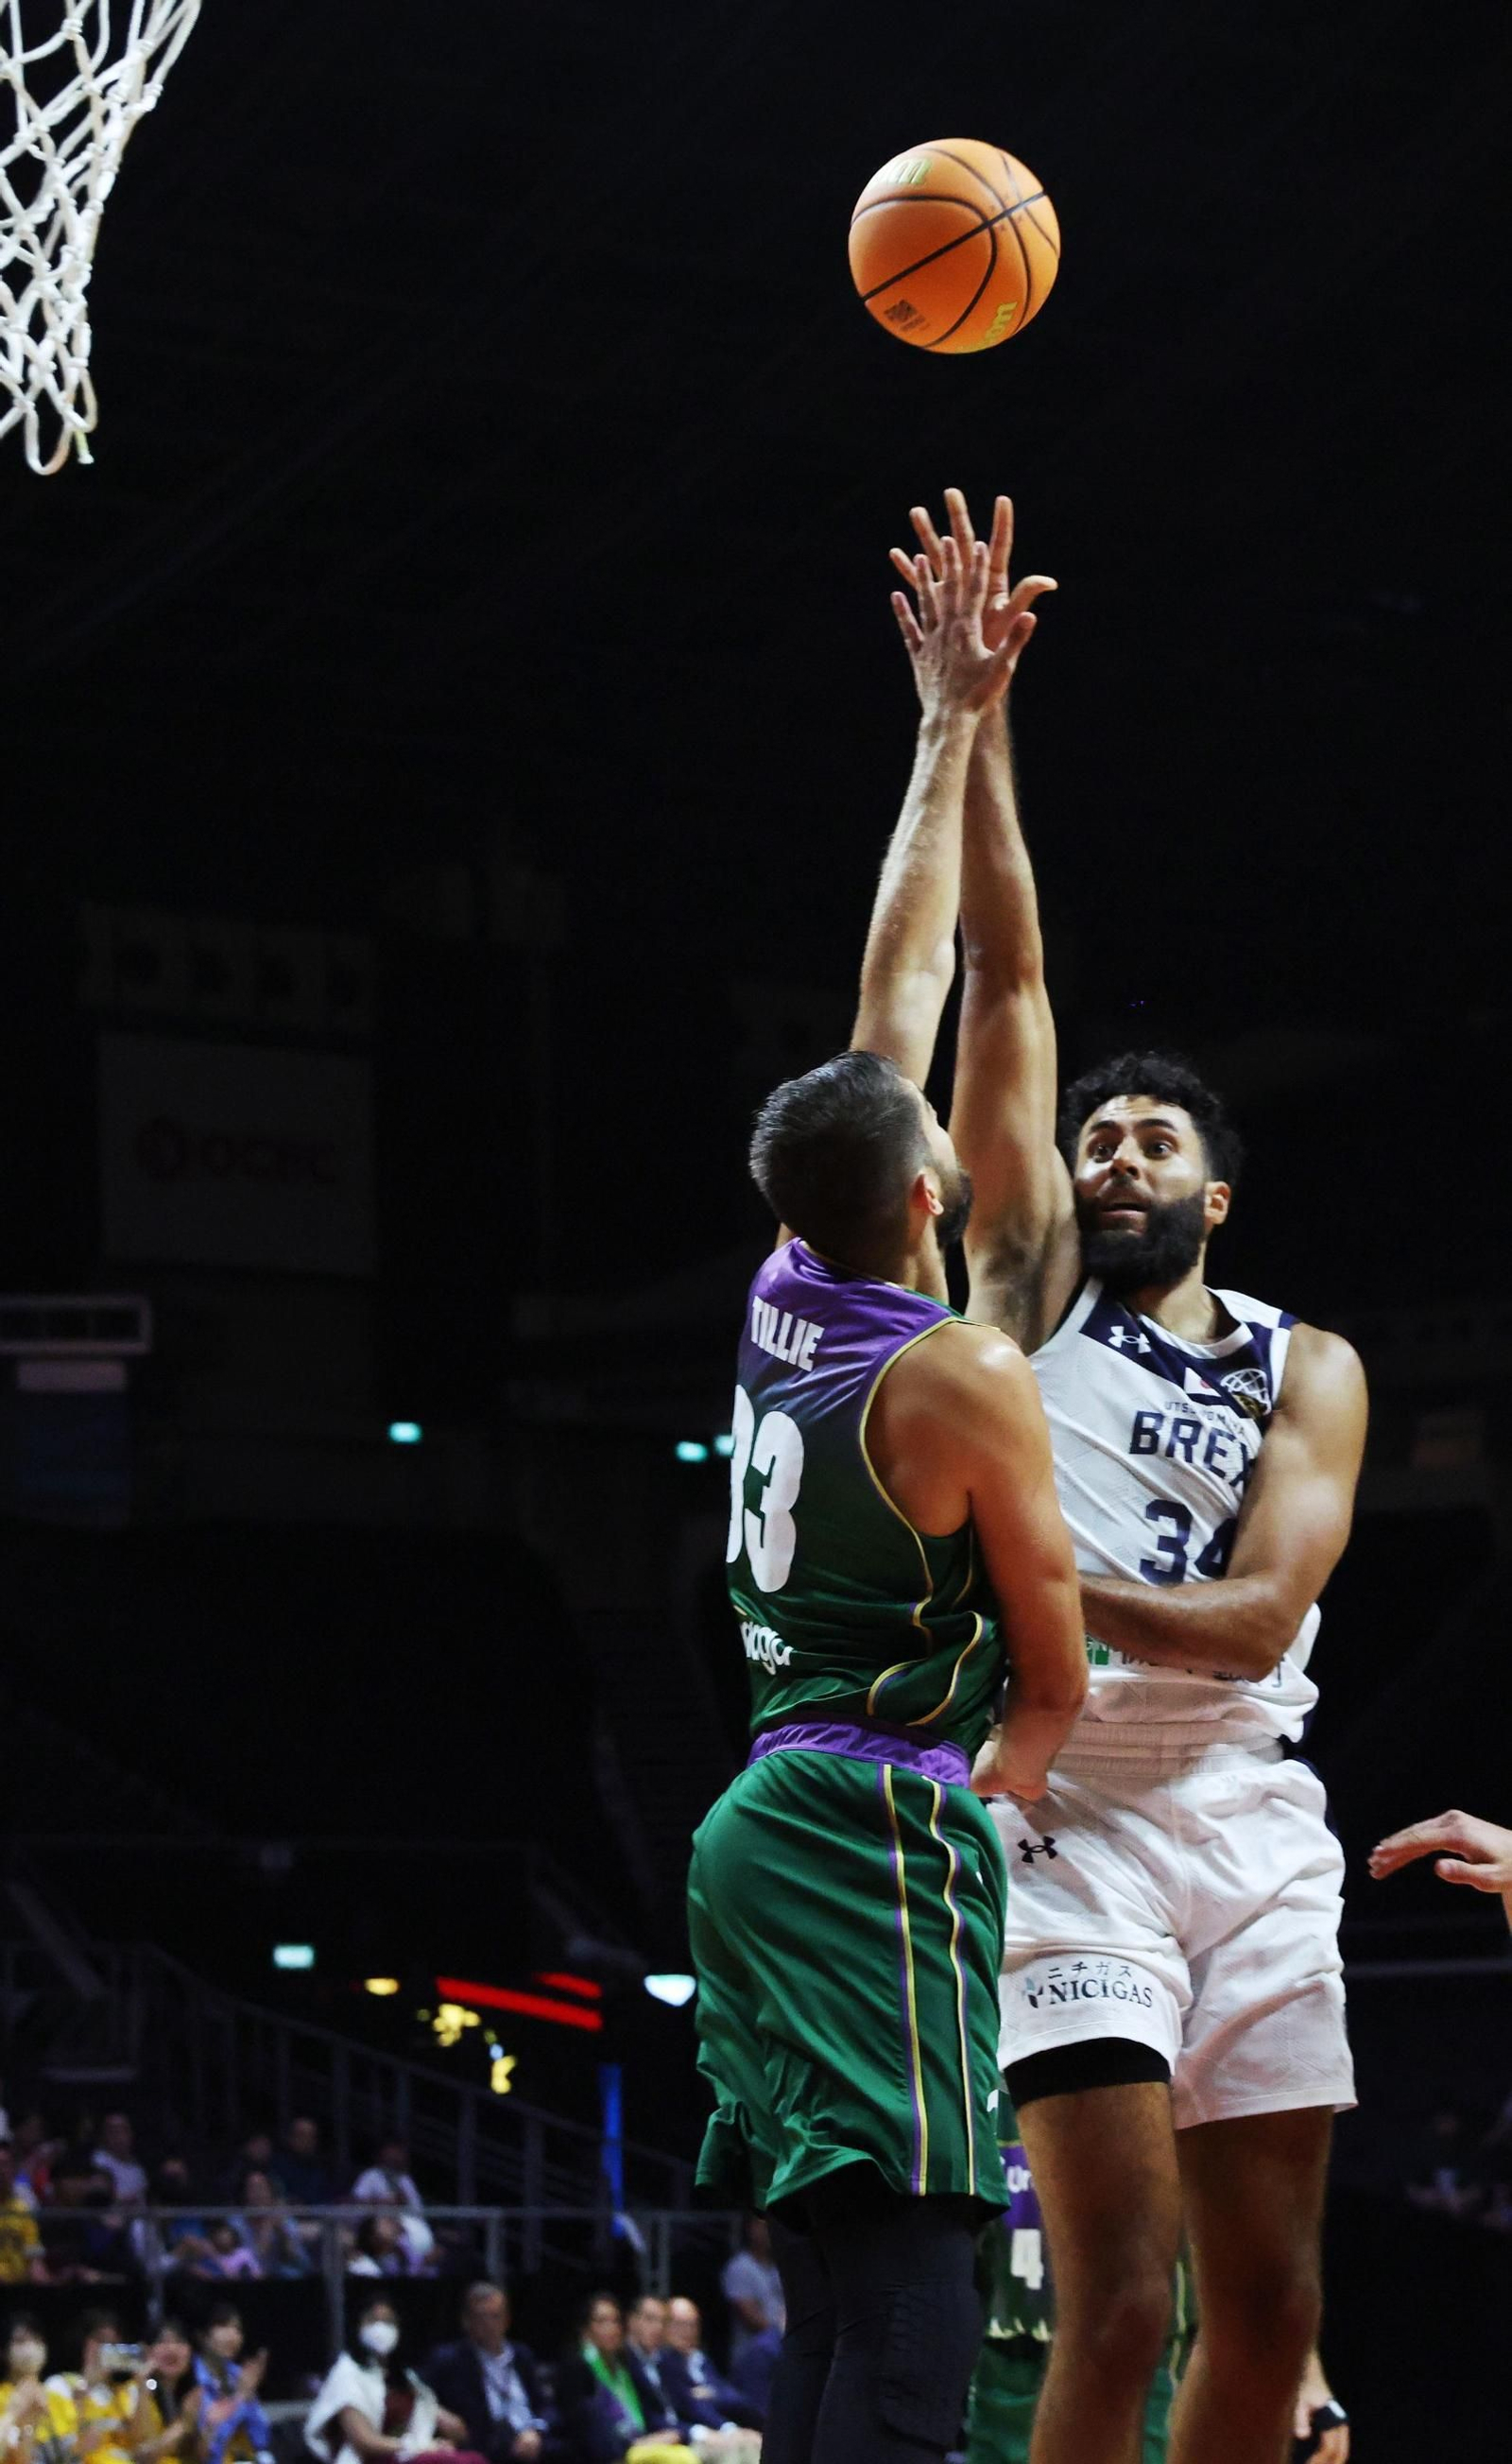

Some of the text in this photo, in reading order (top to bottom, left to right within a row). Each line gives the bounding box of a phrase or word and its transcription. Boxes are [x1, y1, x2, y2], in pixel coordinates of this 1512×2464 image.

[751, 1295, 825, 1372] TILLIE
[1140, 1499, 1238, 1588] 34
[1048, 1961, 1132, 1977] ニチガス
[1048, 1979, 1153, 2007] NICIGAS
